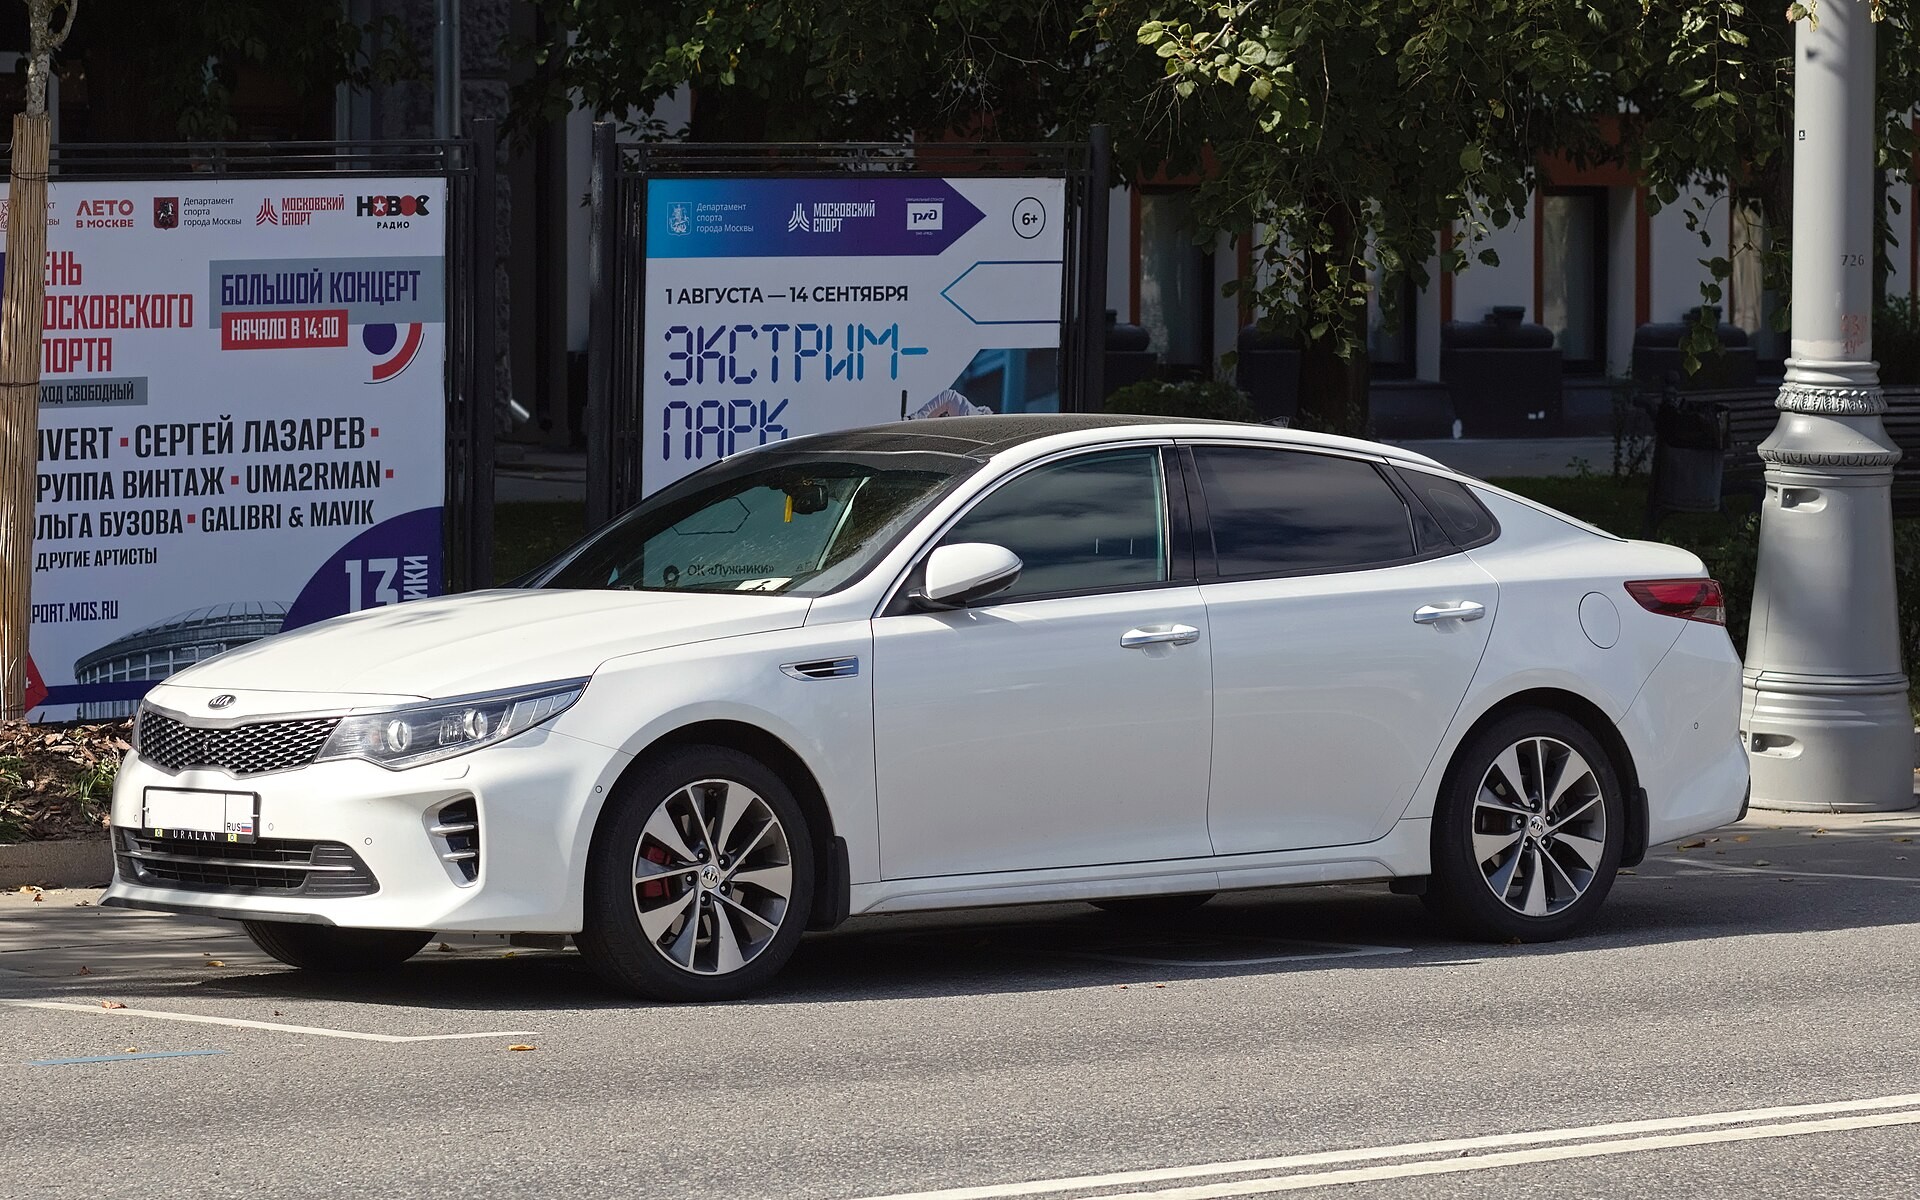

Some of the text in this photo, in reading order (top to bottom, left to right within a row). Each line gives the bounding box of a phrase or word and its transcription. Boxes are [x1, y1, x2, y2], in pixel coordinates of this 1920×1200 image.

[76, 200, 134, 216] ЛЕТО
[184, 197, 234, 207] Департамент
[282, 194, 344, 211] МОСКОВСКИЙ
[696, 203, 746, 213] Департамент
[813, 200, 876, 218] МОСКОВСКИЙ
[184, 209, 210, 217] спорта
[282, 212, 311, 226] СПОРТ
[696, 214, 722, 224] спорта
[1022, 212, 1038, 226] 6+
[76, 219, 134, 228] В МОСКВЕ
[184, 218, 242, 228] города Москвы
[377, 221, 410, 230] РАДИО
[696, 224, 754, 235] города Москвы
[813, 218, 843, 232] СПОРТ
[1841, 254, 1865, 266] 726
[45, 251, 82, 286] НЬ
[221, 268, 421, 306] БОЛЬШОЙ КОНЦЕРТ
[665, 288, 673, 305] 1
[677, 287, 764, 304] АВГУСТА
[789, 286, 808, 304] 14
[812, 285, 909, 303] СЕНТЯБРЯ
[43, 294, 193, 330] ОСКОВСКОГО
[231, 317, 339, 341] НАЧАЛО В 14:00
[664, 322, 929, 386] ЭКСТРИМ-
[40, 381, 134, 404] ХОД СВОБОДНЫЙ
[663, 398, 789, 461] ПАРК
[38, 415, 365, 462] IVERT СЕРГЕЙ ЛАЗАРЕВ
[37, 460, 381, 503] РУППА ВИНТАЖ UMA2RMAN
[33, 500, 375, 541] ЛЬГА БУЗОВА GALIBRI & MAVIK
[35, 547, 158, 572] ДРУГИЕ АРТИСТЫ
[687, 563, 775, 578] ОК «Лужники»
[30, 600, 119, 624] PORT.MOS.RU
[226, 822, 241, 832] RUS
[173, 829, 217, 841] URALAN
[703, 870, 718, 884] KIA
